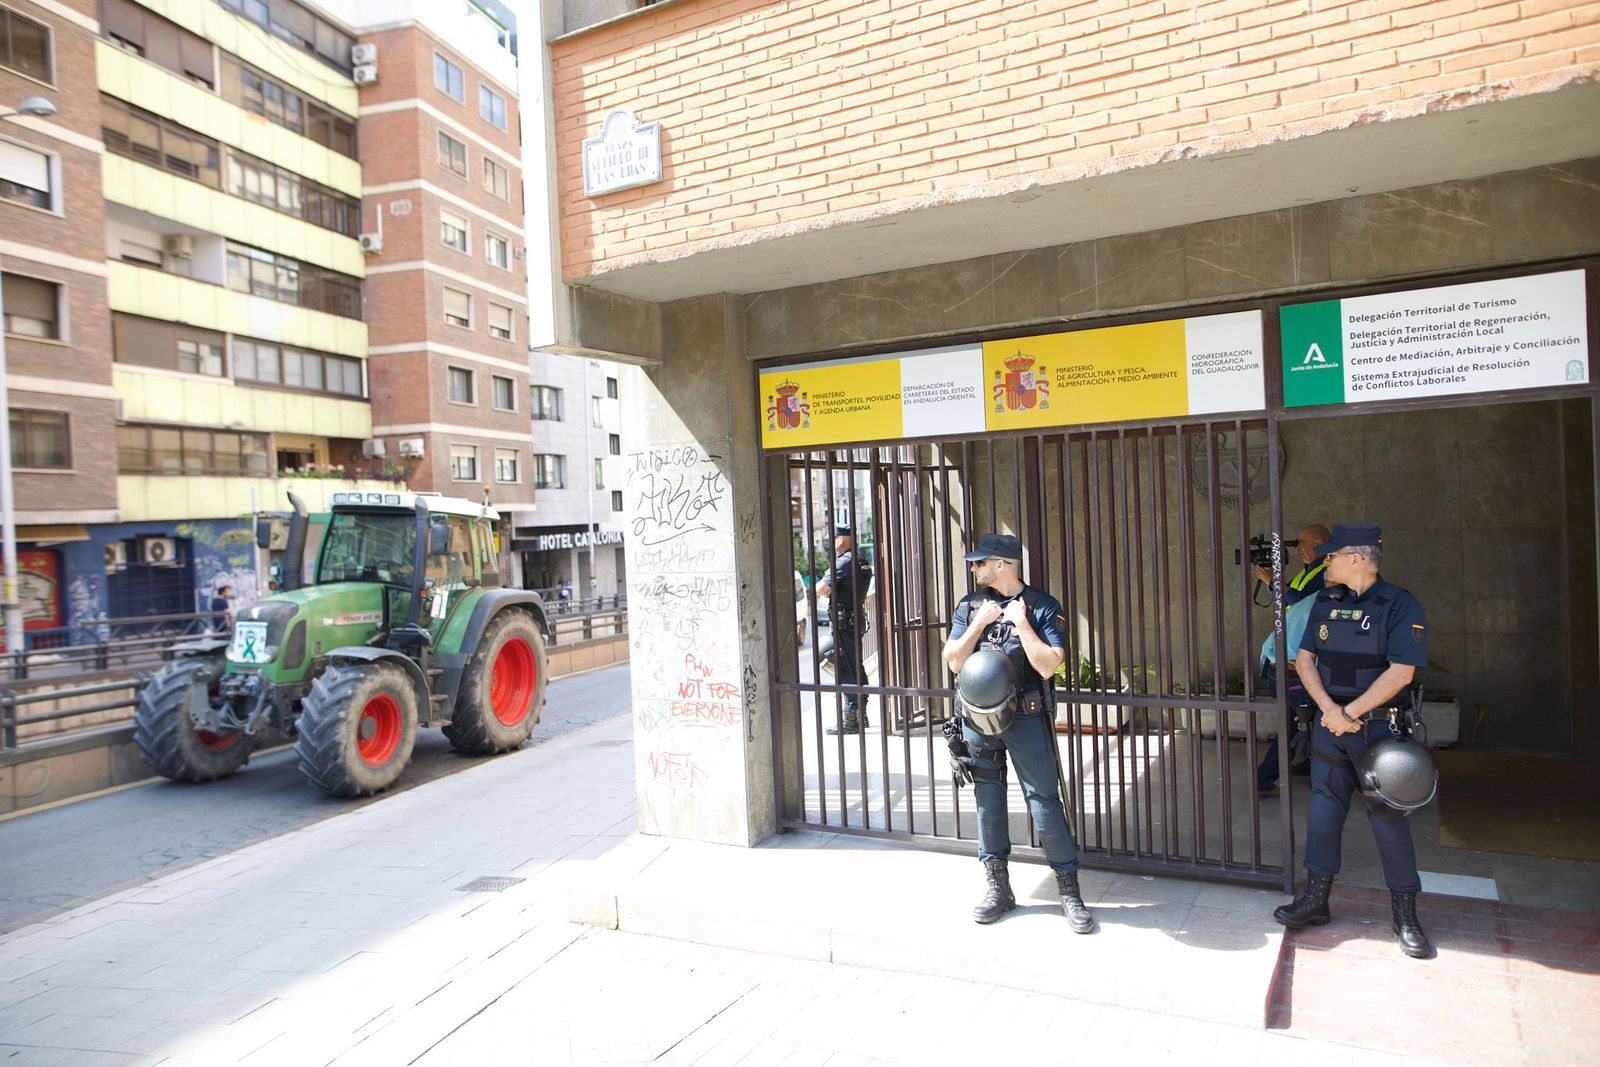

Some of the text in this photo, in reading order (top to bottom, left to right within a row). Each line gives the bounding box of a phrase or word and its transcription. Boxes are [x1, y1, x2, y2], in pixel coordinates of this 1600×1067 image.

[1349, 298, 1517, 324] Delegación Territorial de Turismo
[1350, 311, 1551, 340] Delegación Territorial de Regeneración,
[1350, 326, 1504, 349] Justicia y Administración Local
[1351, 336, 1580, 366] Centro de Mediación, Arbitraje y Conciliación
[1056, 364, 1094, 373] MINISTERIO
[1056, 373, 1066, 381] DE
[1067, 369, 1115, 380] AGRICULTURA
[1123, 366, 1147, 375] PESCA,
[1206, 363, 1260, 374] GUADALQUIVIR
[1352, 358, 1530, 382] Sistema Extrajudicial de Resolución
[1117, 374, 1141, 382] MEDIO
[1142, 371, 1178, 380] AMBIENTE
[1352, 375, 1466, 391] de Conflictos Laborales
[812, 391, 845, 400] MINISTERIO
[903, 390, 938, 399] CARRETERAS
[951, 386, 974, 394] ESTADO
[903, 397, 912, 405] EN
[947, 393, 976, 401] ORIENTAL
[812, 393, 900, 408] DE TRANSPORTES, MOVILIDAD
[819, 406, 845, 415] AGENDA
[846, 405, 871, 413] URBANA
[540, 533, 573, 551] HOTEL
[678, 677, 741, 700] NOT FOR
[671, 701, 742, 725] EVERYONE
